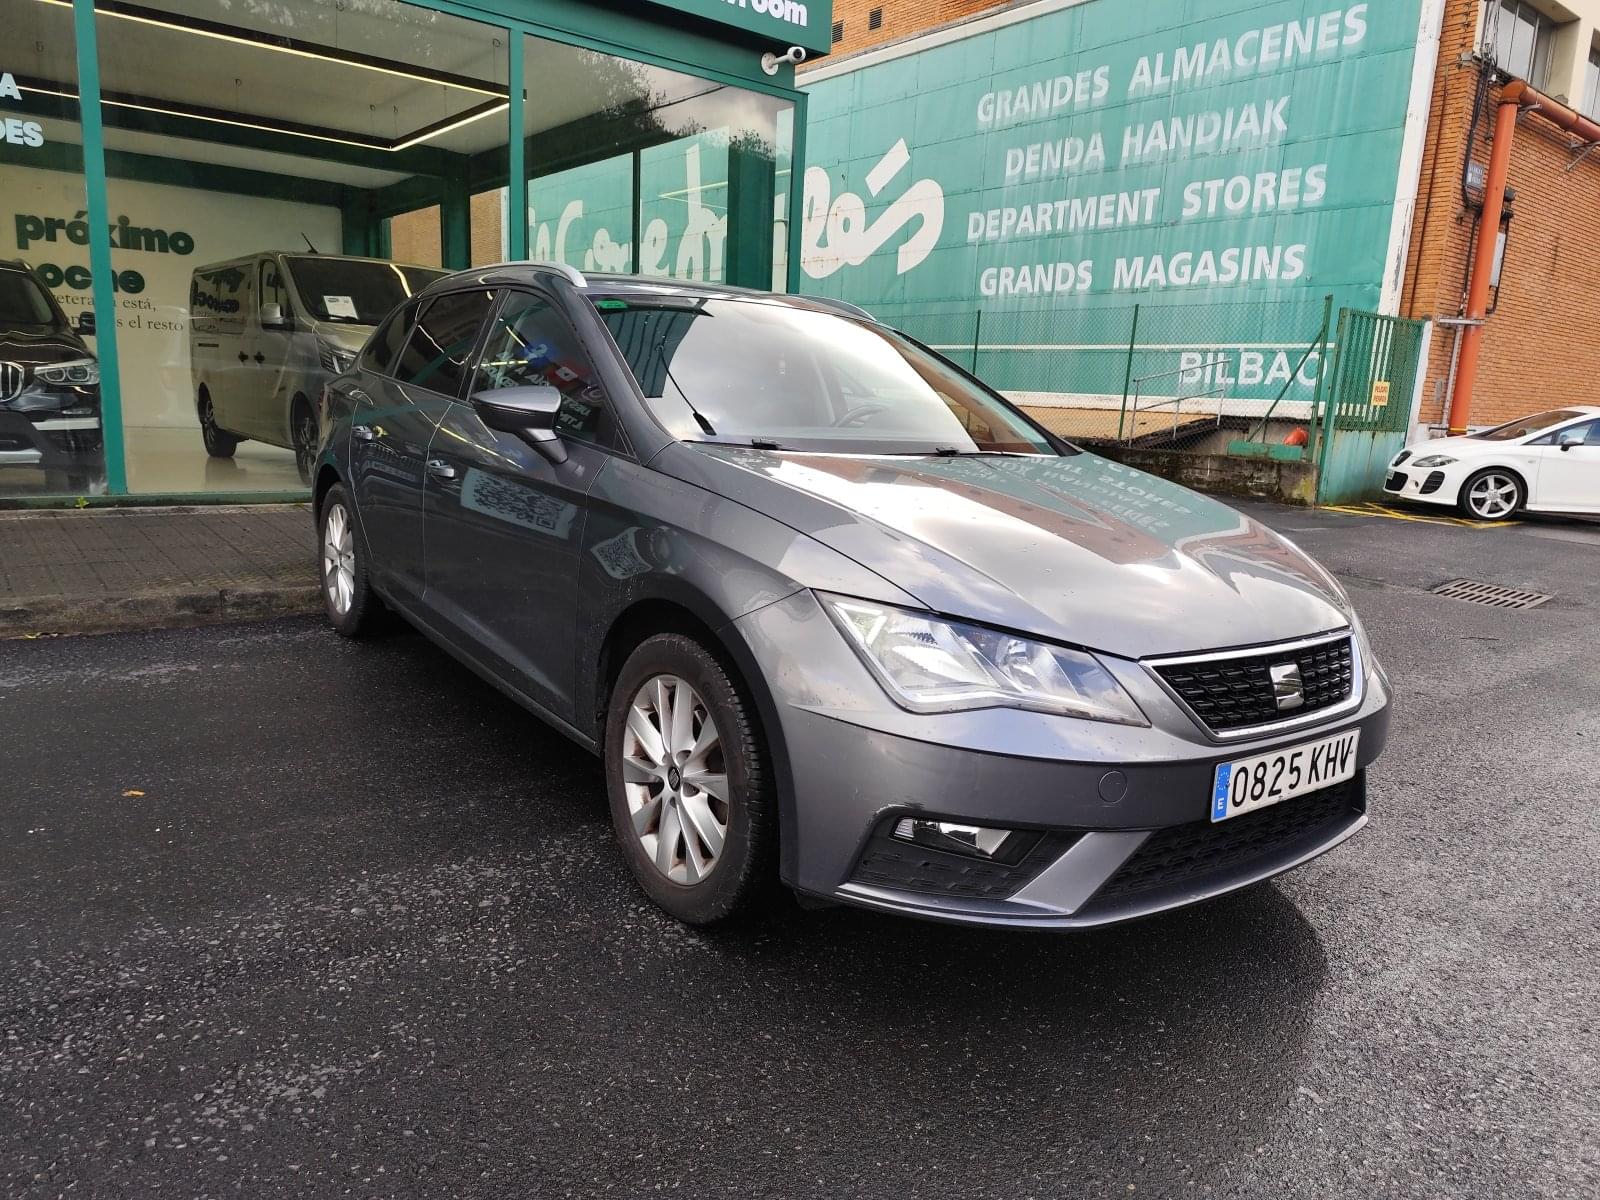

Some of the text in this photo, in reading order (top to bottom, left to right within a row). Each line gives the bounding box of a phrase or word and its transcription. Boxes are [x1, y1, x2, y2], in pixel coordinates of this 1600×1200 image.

[977, 4, 1368, 123] GRANDES ALMACENES
[1005, 96, 1290, 178] DENDA HANDIAK
[966, 164, 1327, 242] DEPARTMENT STORES
[979, 243, 1306, 296] GRANDS MAGASINS
[122, 298, 157, 312] está,
[129, 315, 142, 330] el
[147, 321, 184, 332] resto
[1180, 350, 1327, 386] BILBAO
[1231, 735, 1355, 808] 0825 KHV
[1217, 797, 1225, 810] E
